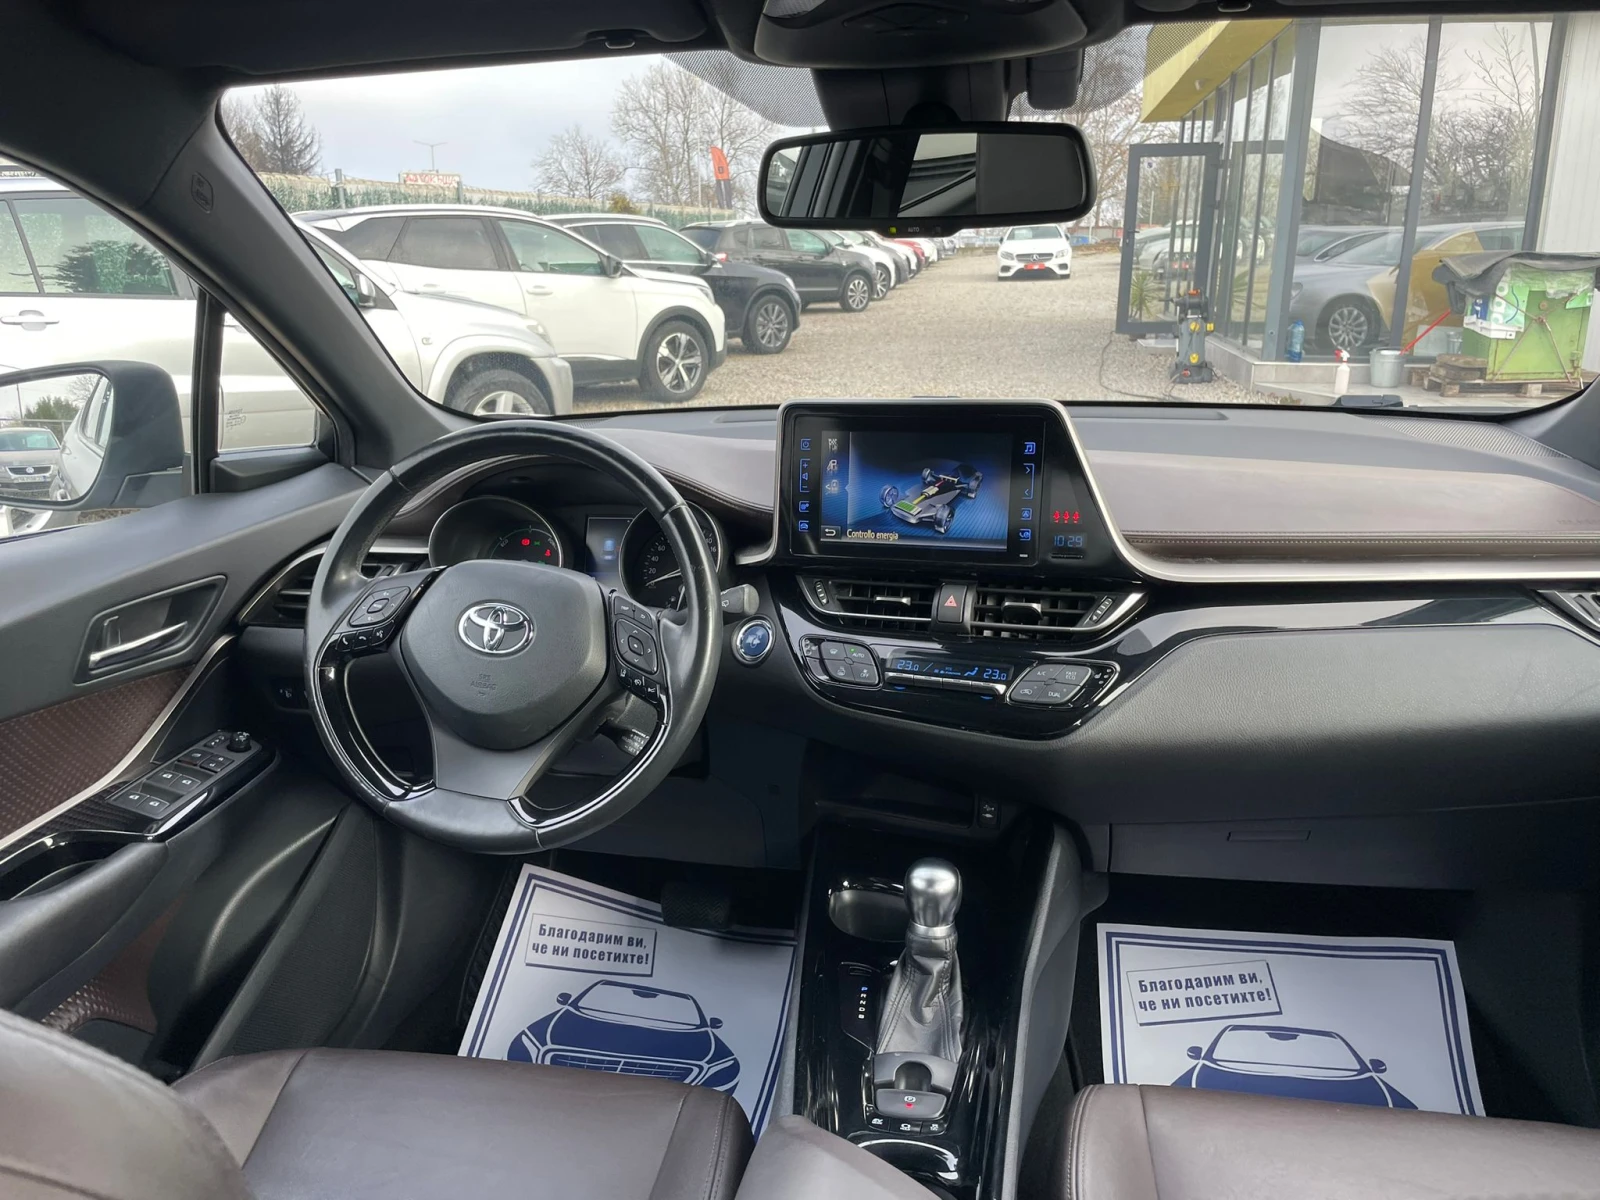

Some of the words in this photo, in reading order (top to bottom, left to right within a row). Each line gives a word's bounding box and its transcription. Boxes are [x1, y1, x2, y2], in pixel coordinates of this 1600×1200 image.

[846, 529, 875, 538] Controllo
[876, 531, 899, 540] energia
[896, 659, 919, 671] 23.0
[983, 668, 1007, 681] 23.0
[538, 923, 623, 946] Благодарим
[627, 936, 647, 949] ви,
[532, 942, 548, 954] че
[552, 945, 569, 957] ни
[572, 947, 650, 965] посетихте!
[1138, 974, 1235, 993] Благодарим
[1238, 972, 1263, 985] ви,
[1138, 1000, 1157, 1012] че
[1161, 997, 1181, 1010] ни
[1184, 987, 1272, 1008] посетихте!
